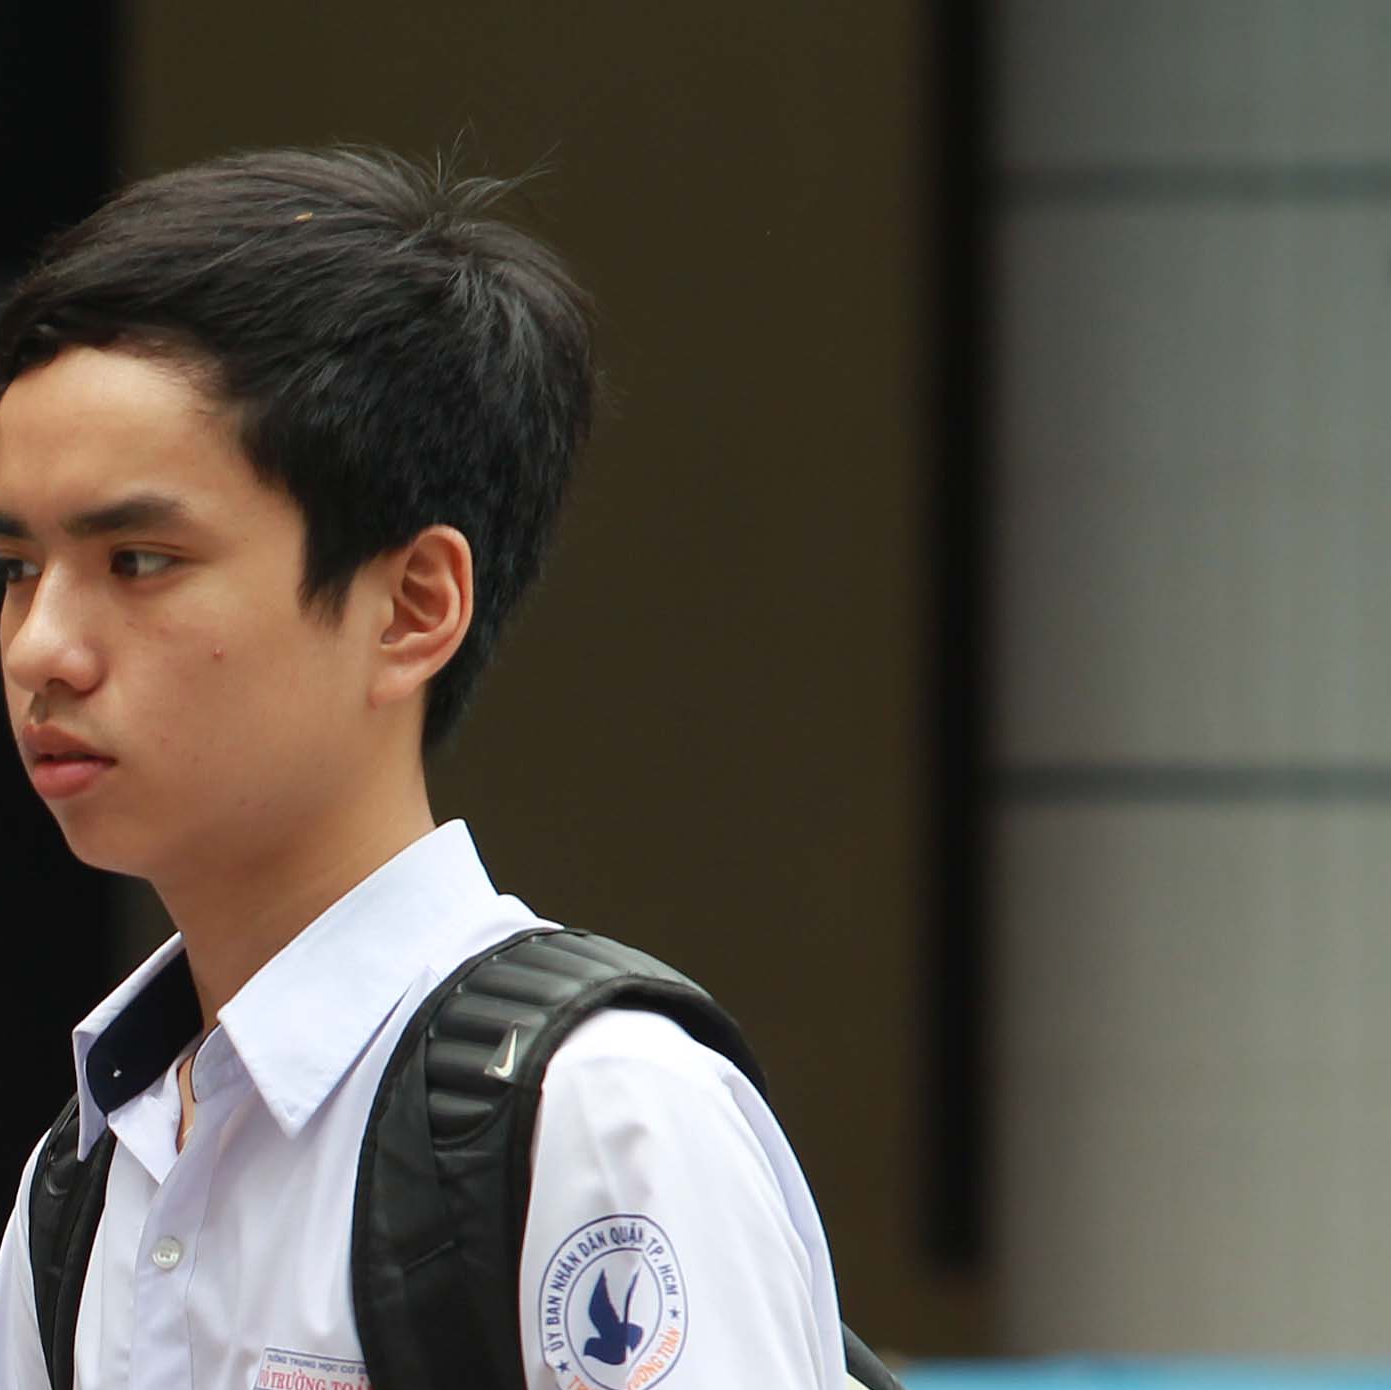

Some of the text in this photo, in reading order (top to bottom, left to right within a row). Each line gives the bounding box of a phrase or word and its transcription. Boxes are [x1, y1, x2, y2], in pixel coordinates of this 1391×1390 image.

[547, 1295, 562, 1326] BAN
[556, 1251, 582, 1294] NHÂN
[659, 1264, 679, 1296] HCM
